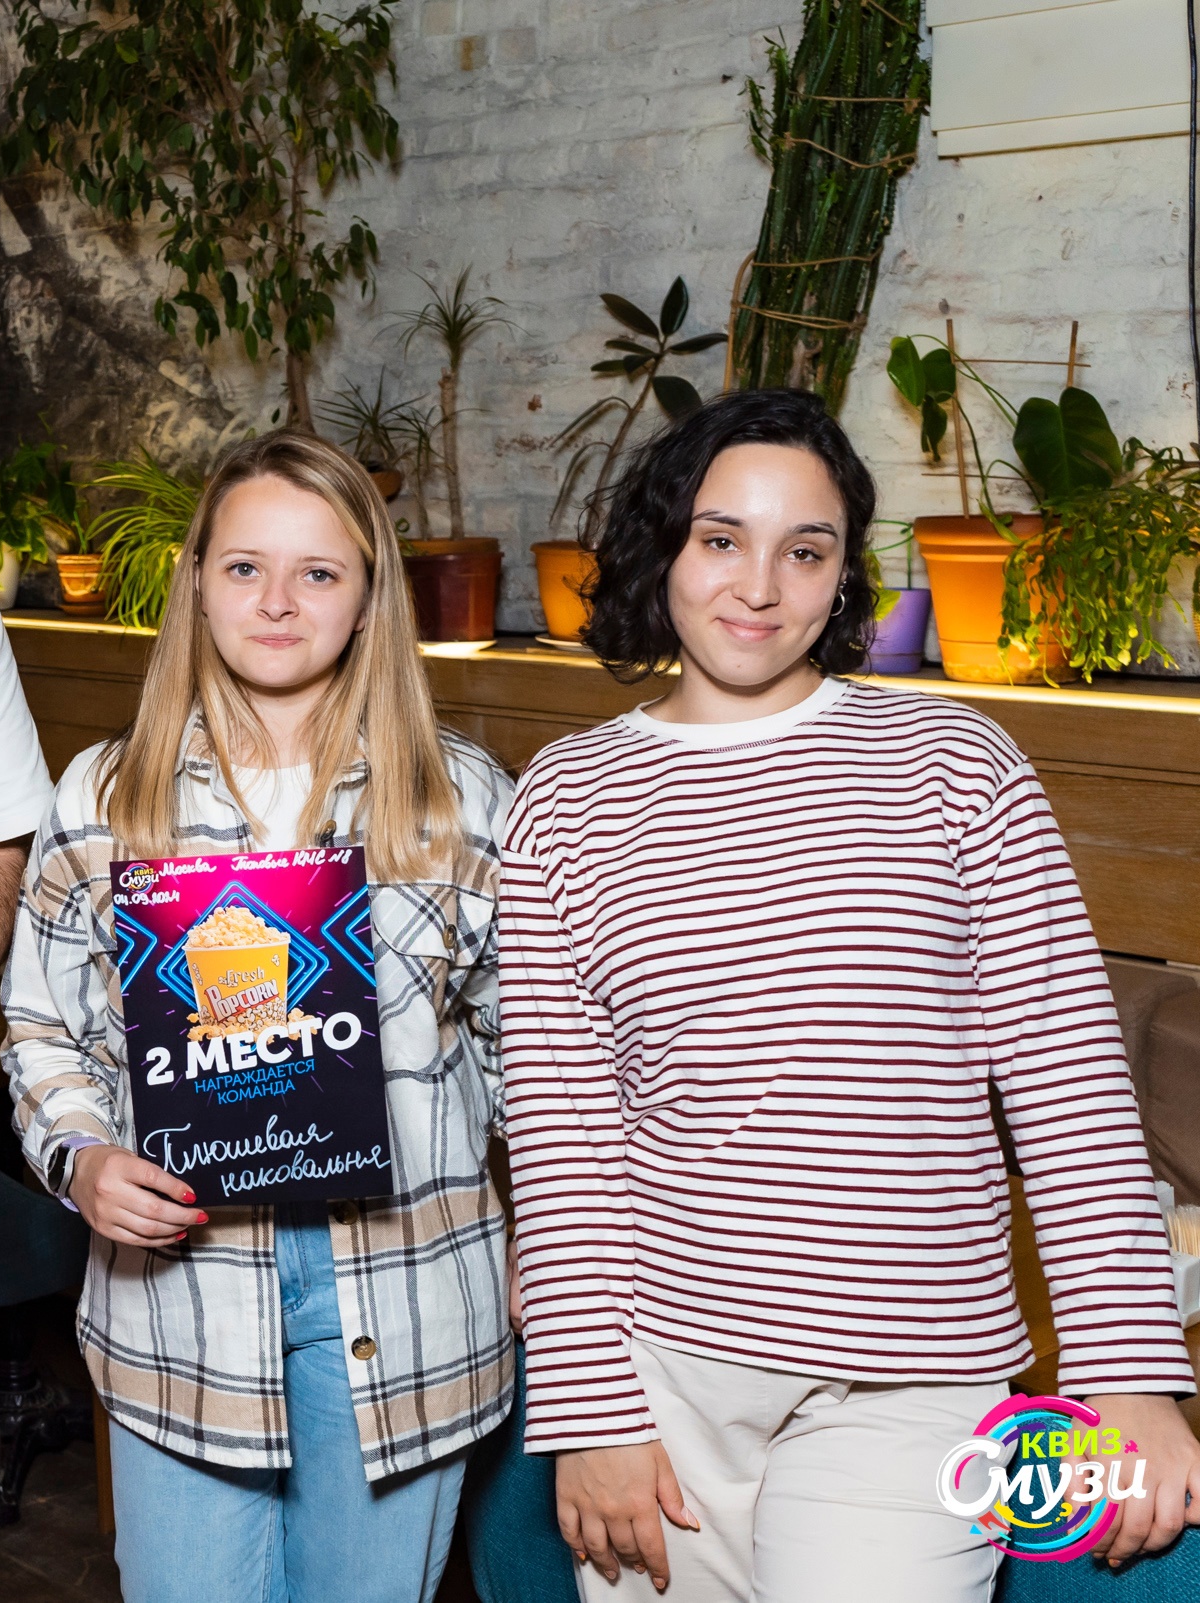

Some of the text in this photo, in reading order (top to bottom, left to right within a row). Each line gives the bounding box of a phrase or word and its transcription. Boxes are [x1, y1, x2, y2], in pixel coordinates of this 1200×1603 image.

[119, 871, 160, 888] Смузи
[134, 867, 154, 876] КВИЗ
[159, 857, 218, 877] Москва
[226, 966, 265, 987] Fresh
[204, 978, 280, 1023] POPCORN
[146, 1011, 363, 1086] 2 МЕСТО
[194, 1058, 316, 1094] НАГРАЖДАЕТСЯ
[217, 1078, 296, 1105] КОМАНДА
[143, 1114, 334, 1175] Плюшевая
[220, 1144, 392, 1198] наковальня
